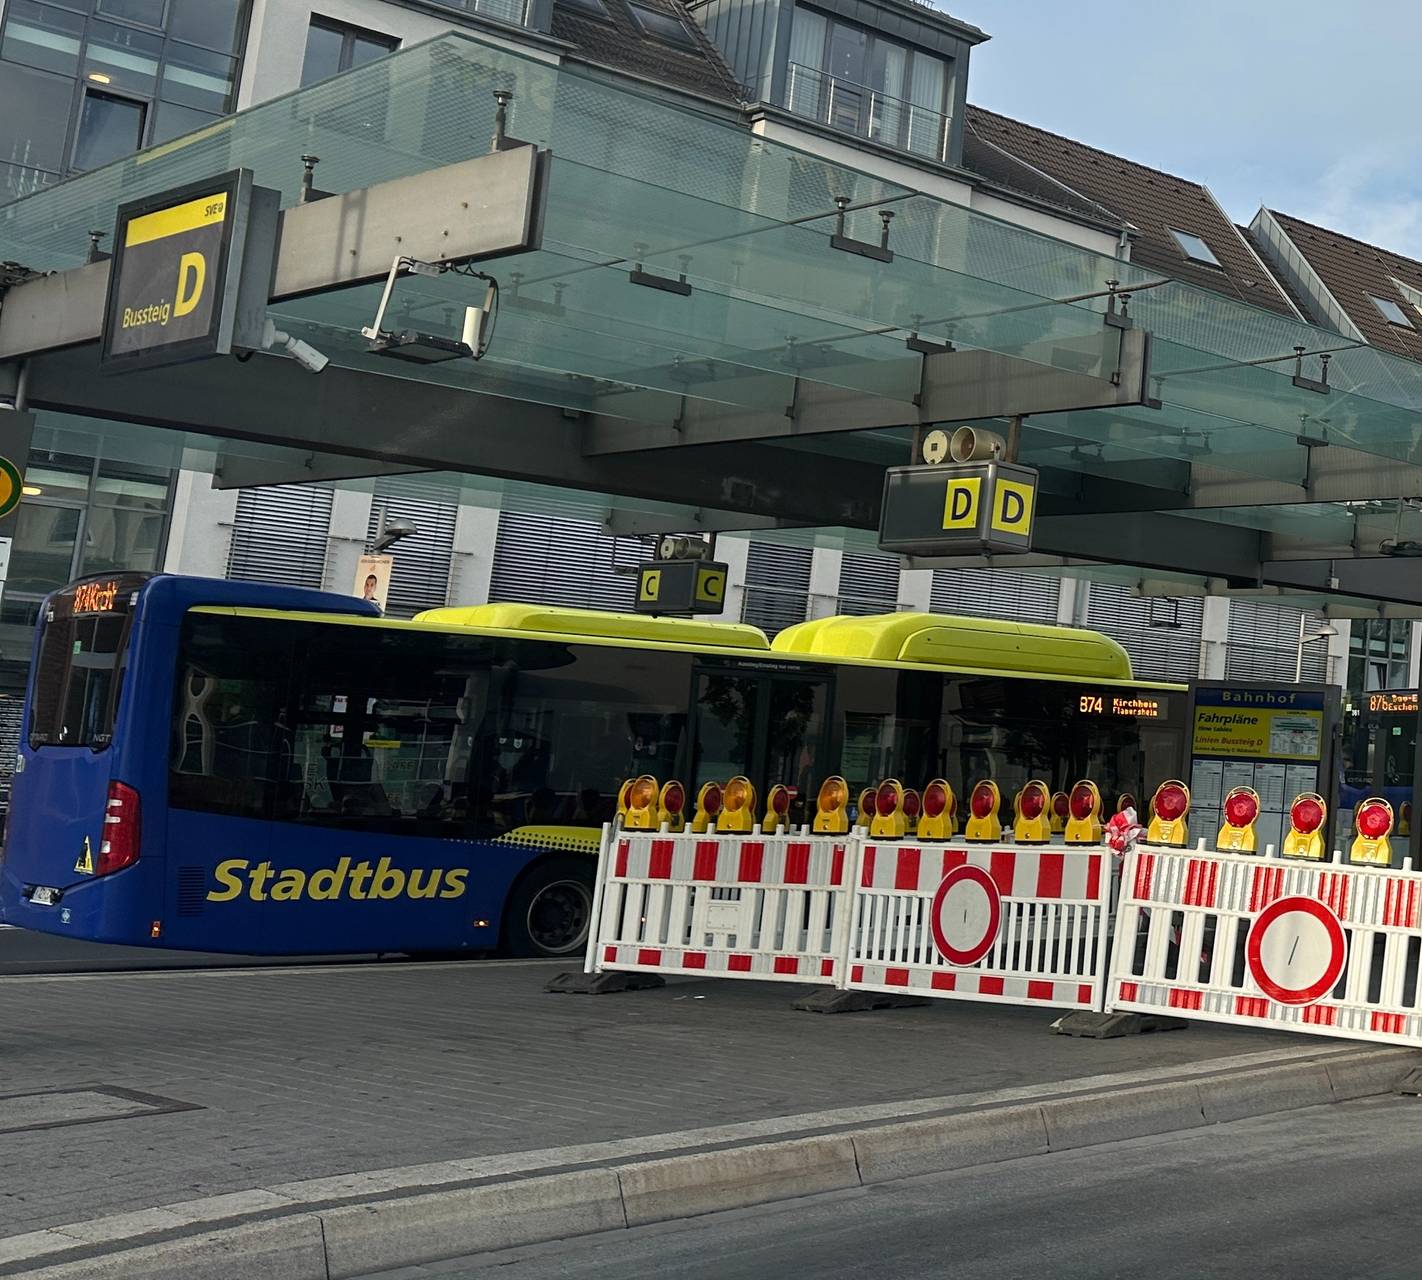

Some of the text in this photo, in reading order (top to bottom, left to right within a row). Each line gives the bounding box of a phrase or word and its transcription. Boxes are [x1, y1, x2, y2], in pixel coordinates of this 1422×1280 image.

[204, 203, 217, 217] SVE
[122, 252, 206, 328] Bussteig D
[951, 487, 972, 520] D
[1002, 490, 1024, 523] D
[646, 576, 656, 596] C
[703, 575, 719, 597] C
[1080, 696, 1158, 713] 874 Kirchheim
[1222, 691, 1297, 704] Bahnhof
[1197, 713, 1259, 726] Fahrpläne
[1195, 736, 1219, 744] Linien
[1221, 737, 1255, 747] Bussteig
[206, 856, 469, 901] Stadtbus
